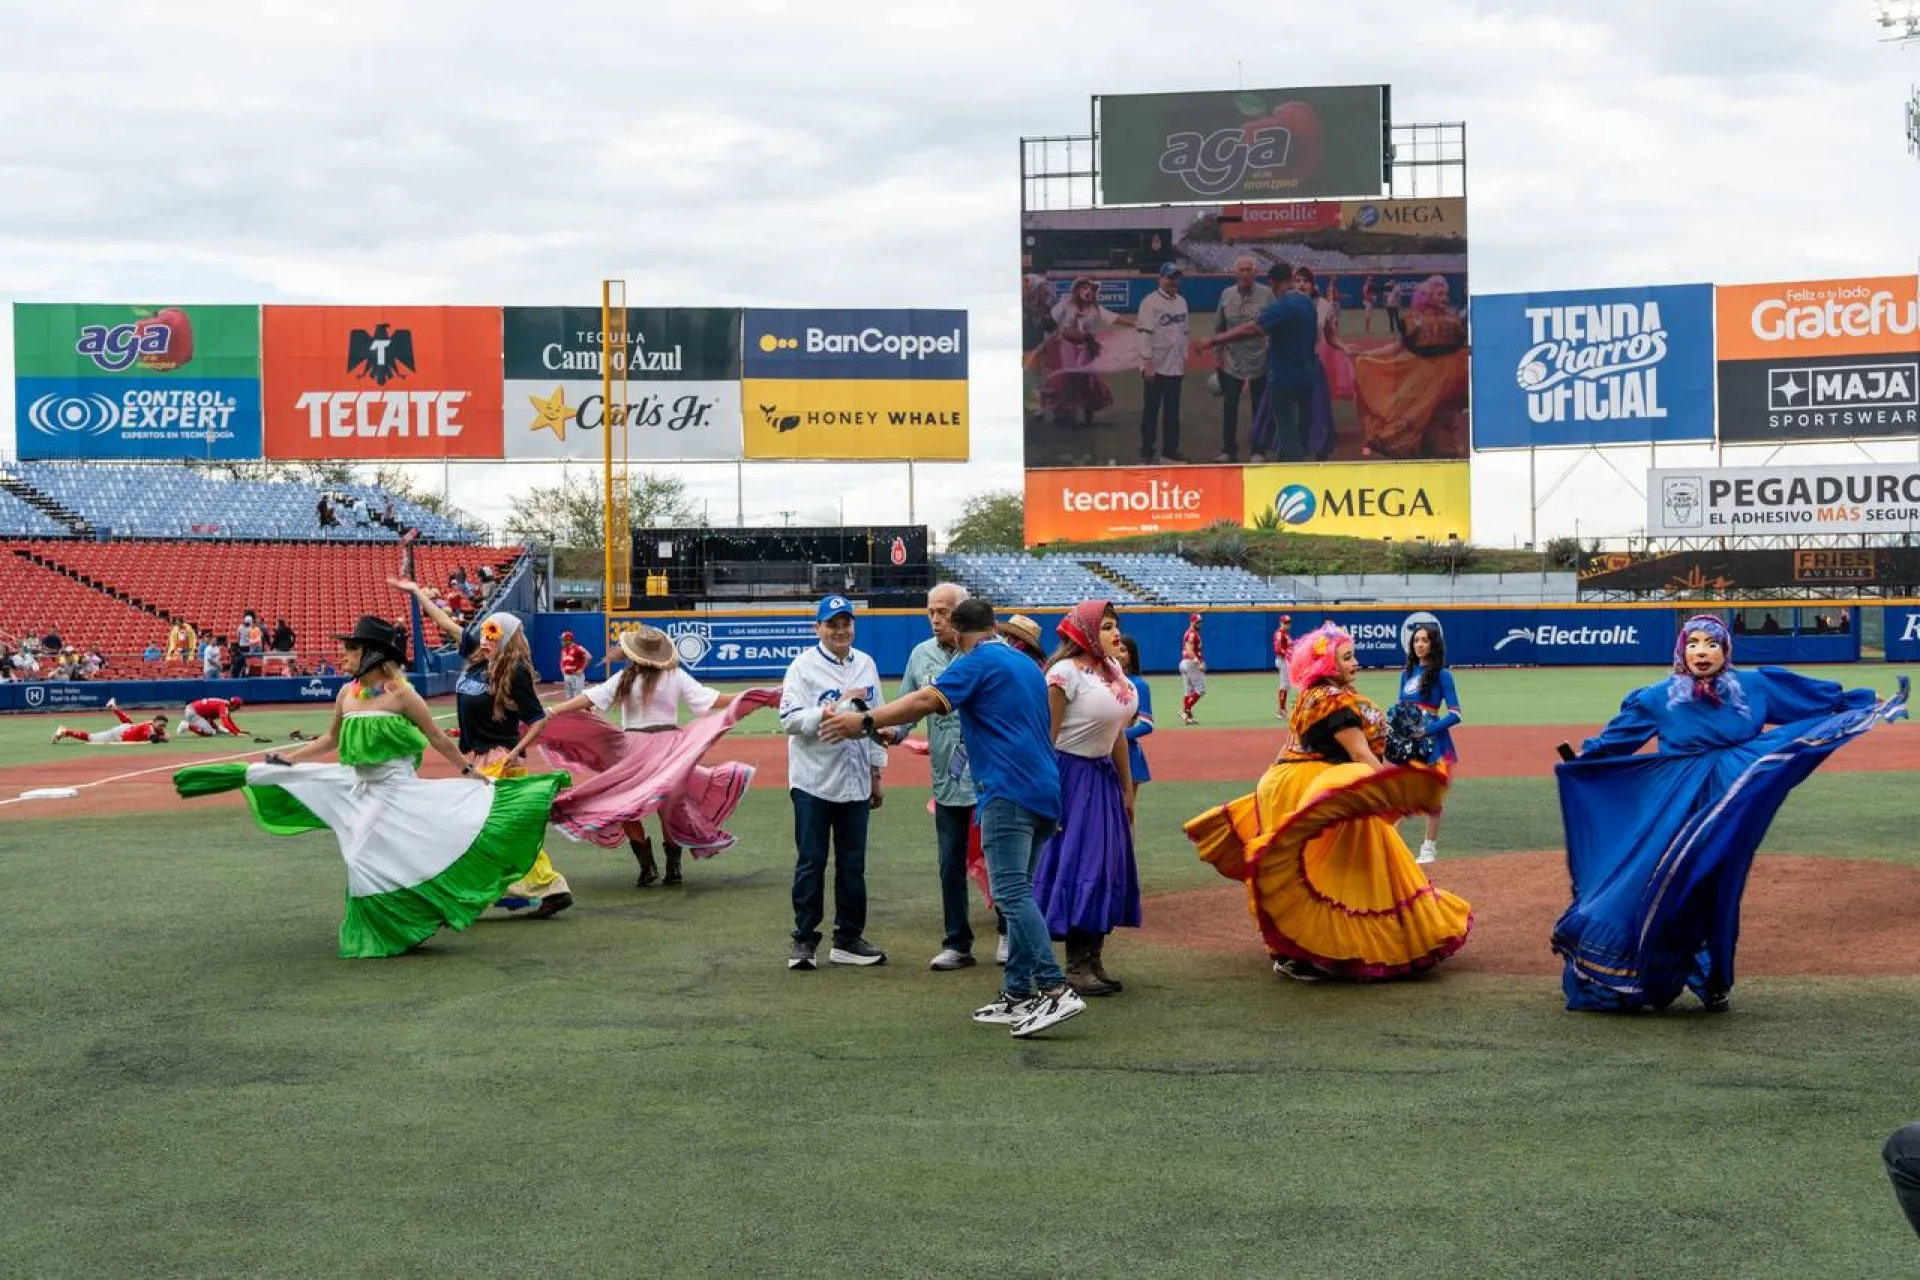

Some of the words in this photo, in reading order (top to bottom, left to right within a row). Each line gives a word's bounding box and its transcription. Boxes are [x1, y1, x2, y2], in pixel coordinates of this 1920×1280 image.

[1159, 127, 1291, 195] aga
[1380, 205, 1444, 224] MEGA
[1525, 301, 1661, 346] TIENDA
[1751, 291, 1918, 342] Gratefu
[76, 323, 171, 372] aga
[629, 344, 682, 372] Azul
[806, 327, 960, 360] BanCoppel
[1516, 330, 1668, 389] Charros
[123, 389, 226, 406] CONTROL
[1528, 367, 1668, 423] OFICIAL
[1816, 371, 1911, 402] MAJA
[121, 406, 236, 429] EXPERT
[295, 391, 466, 438] TECATE
[668, 395, 713, 431] Jr.
[807, 410, 878, 426] HONEY
[888, 410, 961, 426] WHALE
[1769, 409, 1917, 428] SPORTSWEAR
[1063, 480, 1201, 511] tecnolite
[1321, 487, 1434, 518] MEGA
[1709, 474, 1920, 507] PEGADURO
[1709, 512, 1727, 525] EL
[1731, 510, 1813, 523] ADHESIVO
[1817, 504, 1861, 522] MÁS
[1866, 508, 1920, 521] SEGUR
[1801, 552, 1870, 567] FRIES
[1804, 569, 1866, 578] AVENUE
[1535, 625, 1638, 645] Electrolit
